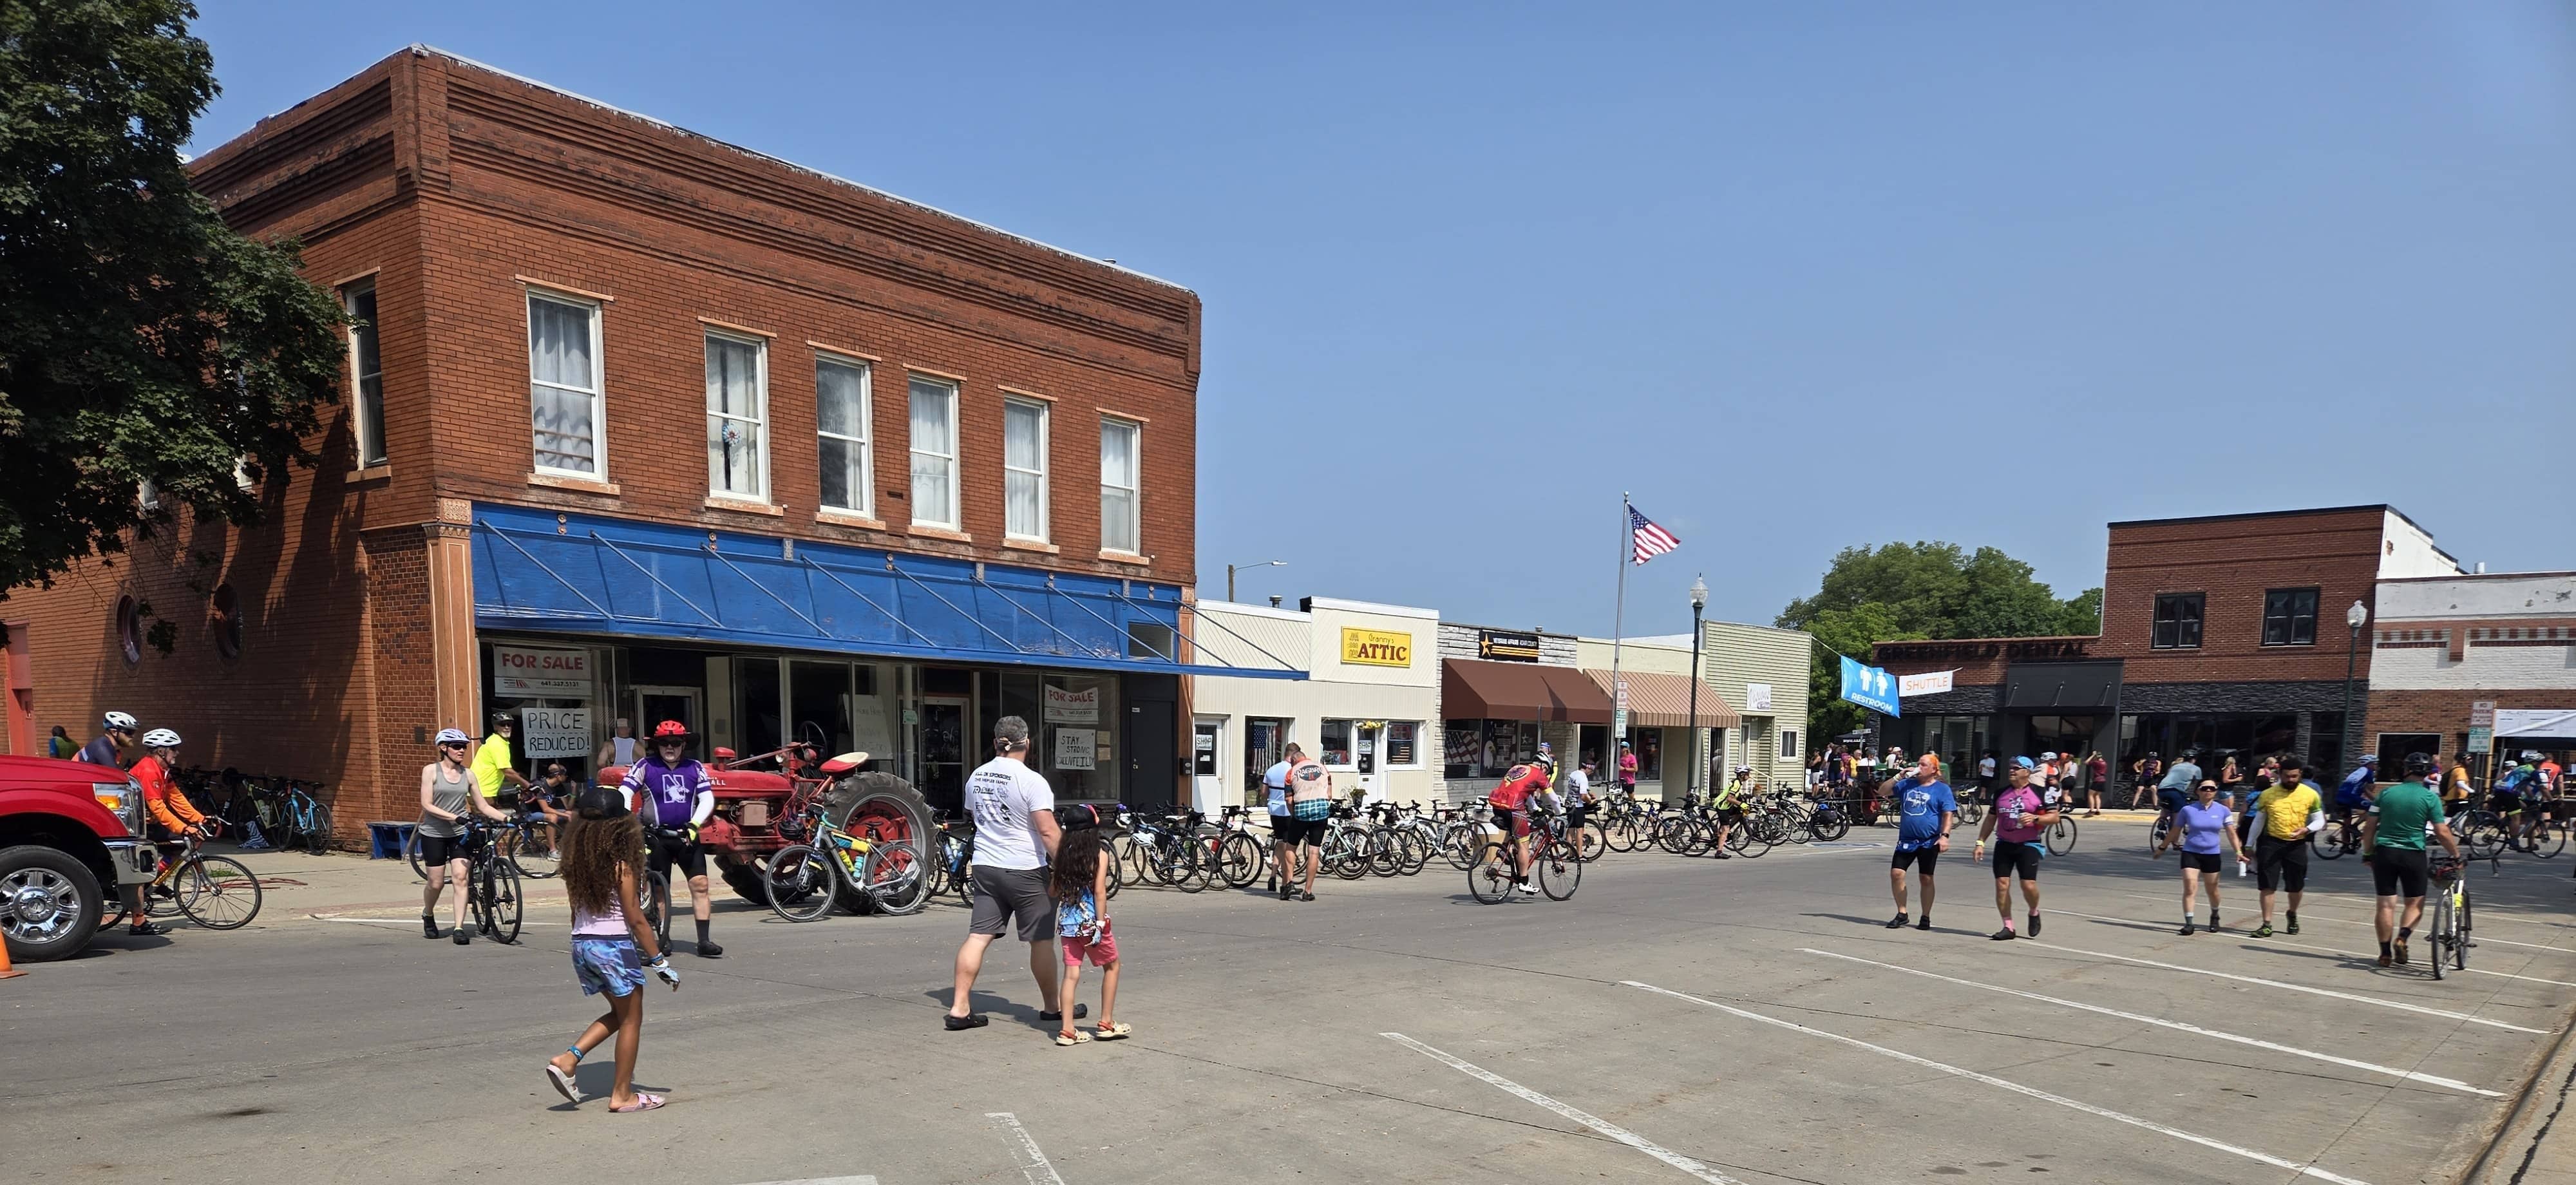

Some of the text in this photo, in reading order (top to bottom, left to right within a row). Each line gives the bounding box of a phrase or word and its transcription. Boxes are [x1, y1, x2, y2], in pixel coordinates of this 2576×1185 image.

[1368, 633, 1394, 644] Granny's
[1358, 643, 1407, 661] ATTIC
[1878, 641, 2088, 660] GREENFIELD DENTAL
[502, 653, 583, 670] FOR SALE
[1906, 677, 1947, 691] SHUTTLE
[1048, 690, 1094, 703] FOR SALE
[1852, 692, 1893, 712] RESTROOM
[528, 712, 584, 729] PRICE
[529, 736, 590, 752] REDUCED!
[1061, 735, 1080, 745] STAY
